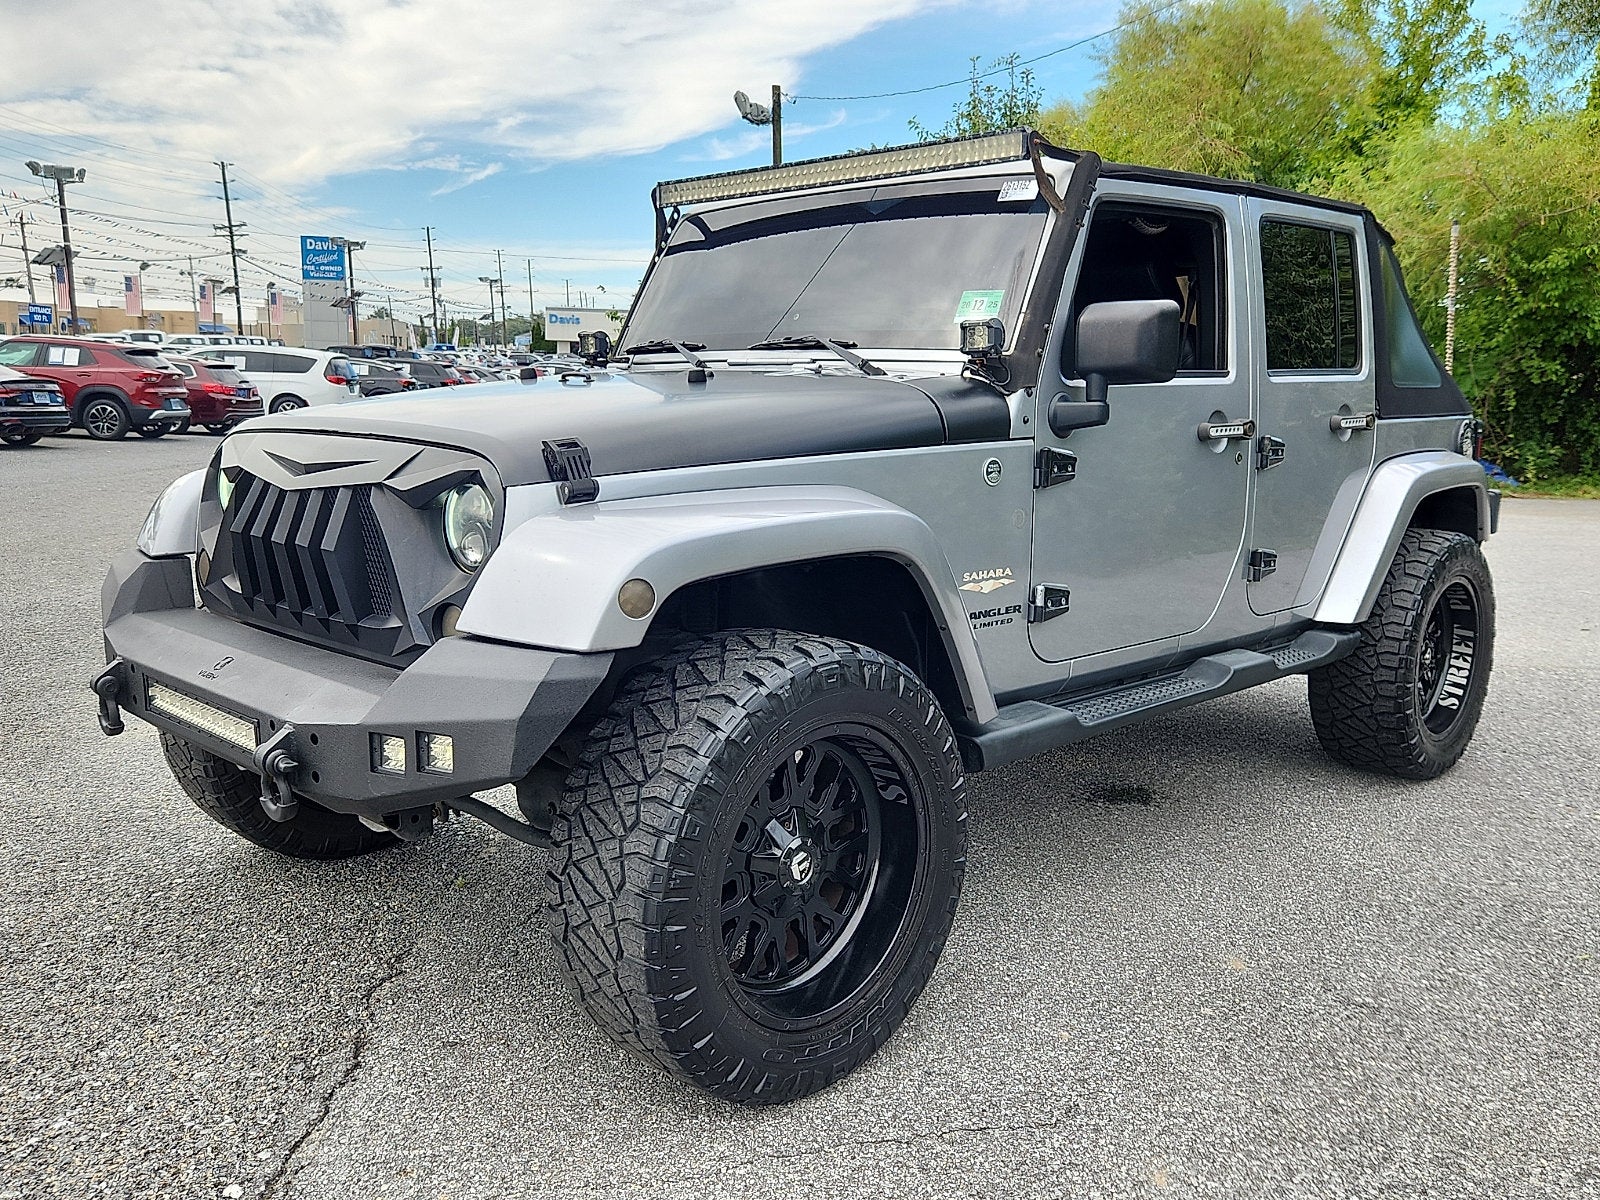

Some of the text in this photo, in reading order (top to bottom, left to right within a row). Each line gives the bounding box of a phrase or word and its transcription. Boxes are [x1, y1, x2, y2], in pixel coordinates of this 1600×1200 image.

[306, 238, 337, 250] Davis
[306, 252, 339, 265] Certified
[972, 299, 985, 311] 12
[987, 300, 999, 309] 25
[548, 313, 581, 325] Davis
[962, 567, 1012, 581] SAHARA
[969, 604, 1022, 621] ANGLER
[972, 617, 1014, 630] LIMITED
[1437, 623, 1476, 710] STREET
